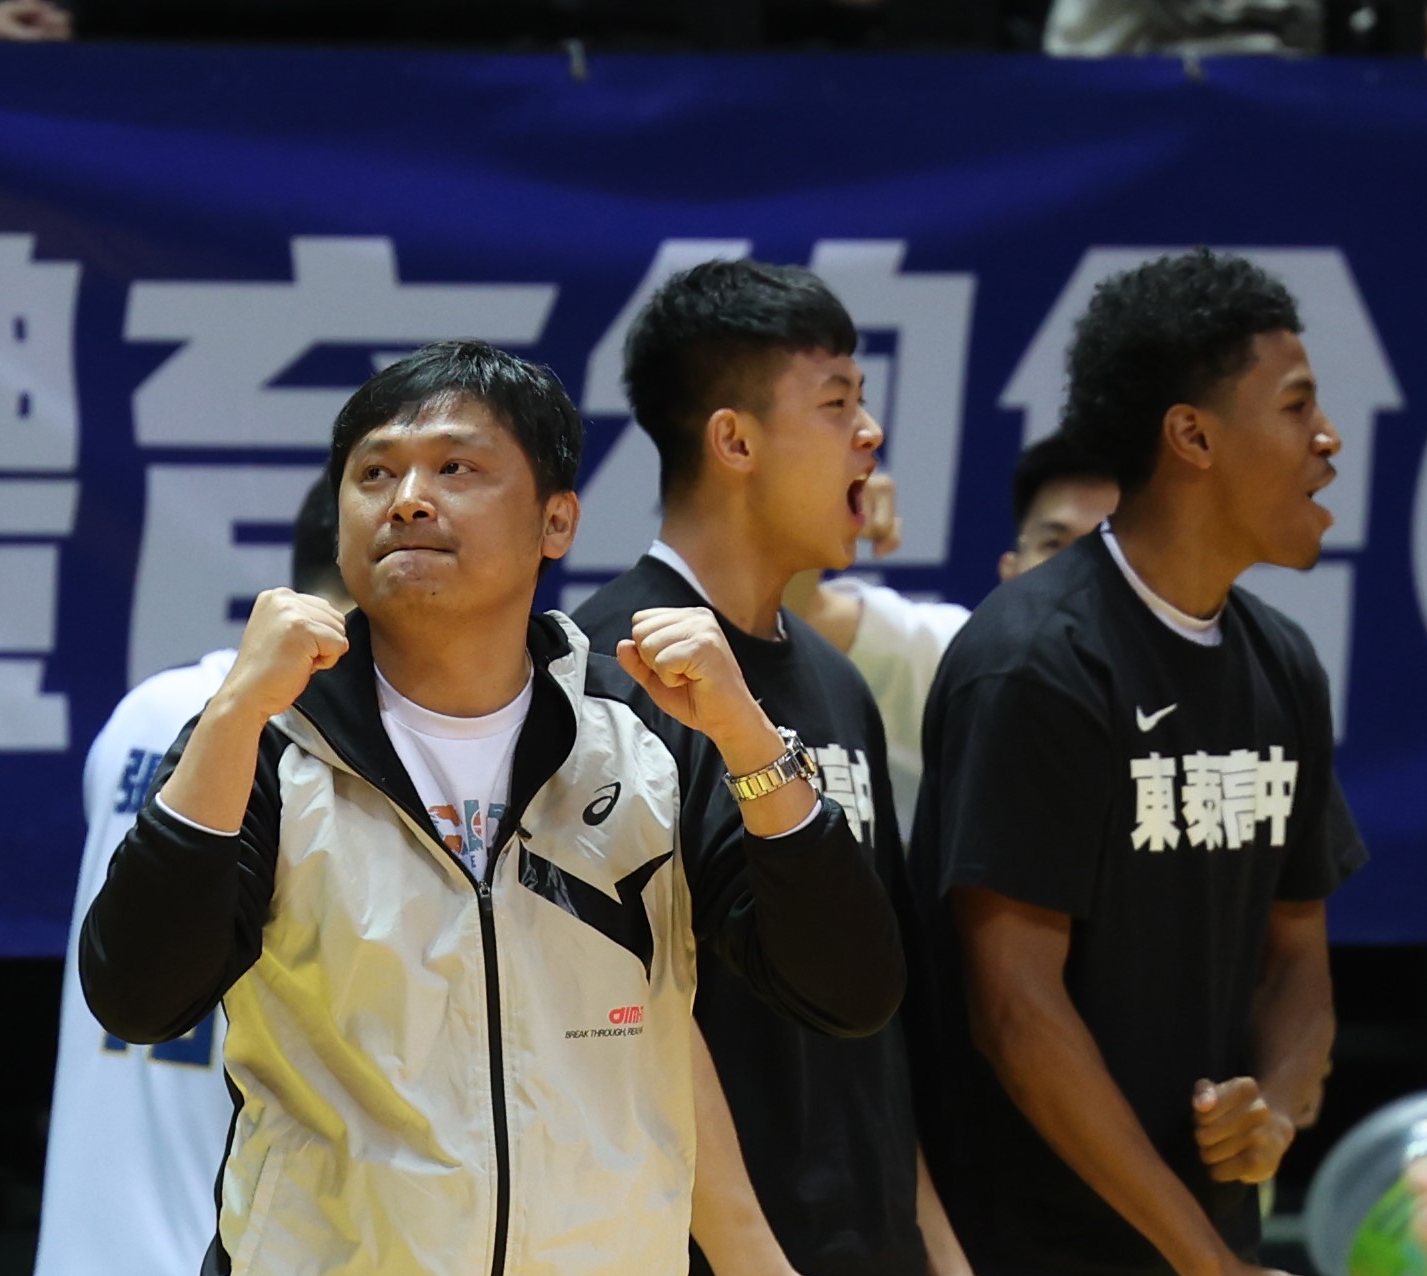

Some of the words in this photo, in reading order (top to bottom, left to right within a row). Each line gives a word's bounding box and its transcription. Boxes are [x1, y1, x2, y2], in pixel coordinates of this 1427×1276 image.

[805, 743, 875, 849] 高中
[1129, 745, 1299, 851] 東泰高中
[565, 1030, 589, 1039] BREAK
